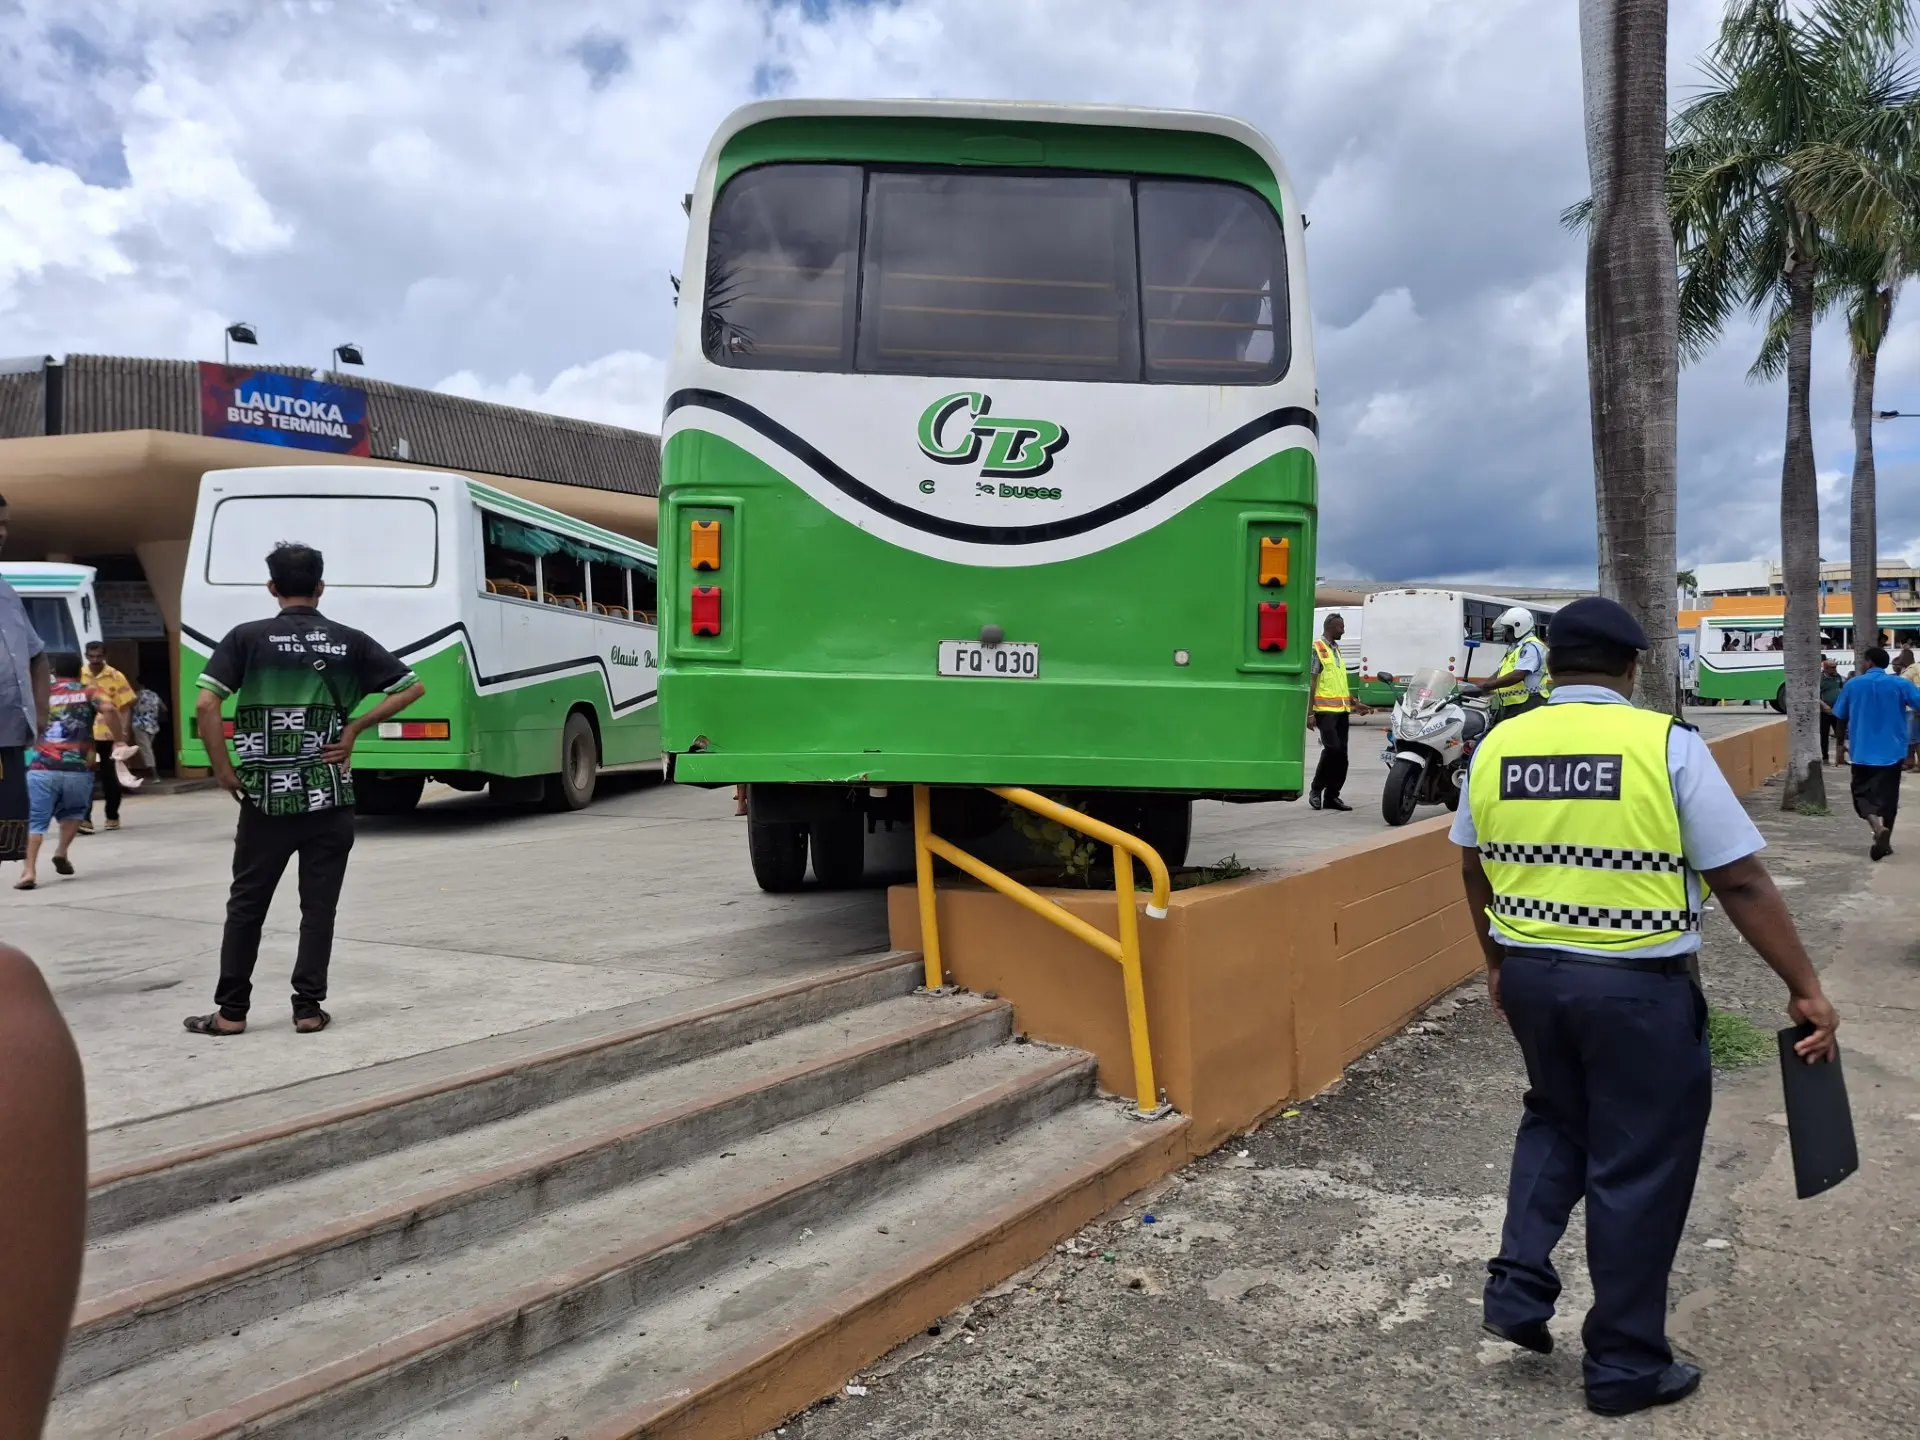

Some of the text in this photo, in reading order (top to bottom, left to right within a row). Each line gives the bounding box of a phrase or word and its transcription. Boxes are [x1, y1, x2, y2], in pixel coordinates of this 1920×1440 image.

[234, 388, 344, 423] LAUTOKA
[227, 407, 352, 439] BUS TERMINAL
[999, 483, 1063, 500] buses
[284, 643, 291, 652] B
[611, 645, 639, 667] Classic
[1422, 722, 1444, 735] POLICE
[1506, 762, 1614, 792] POLICE
